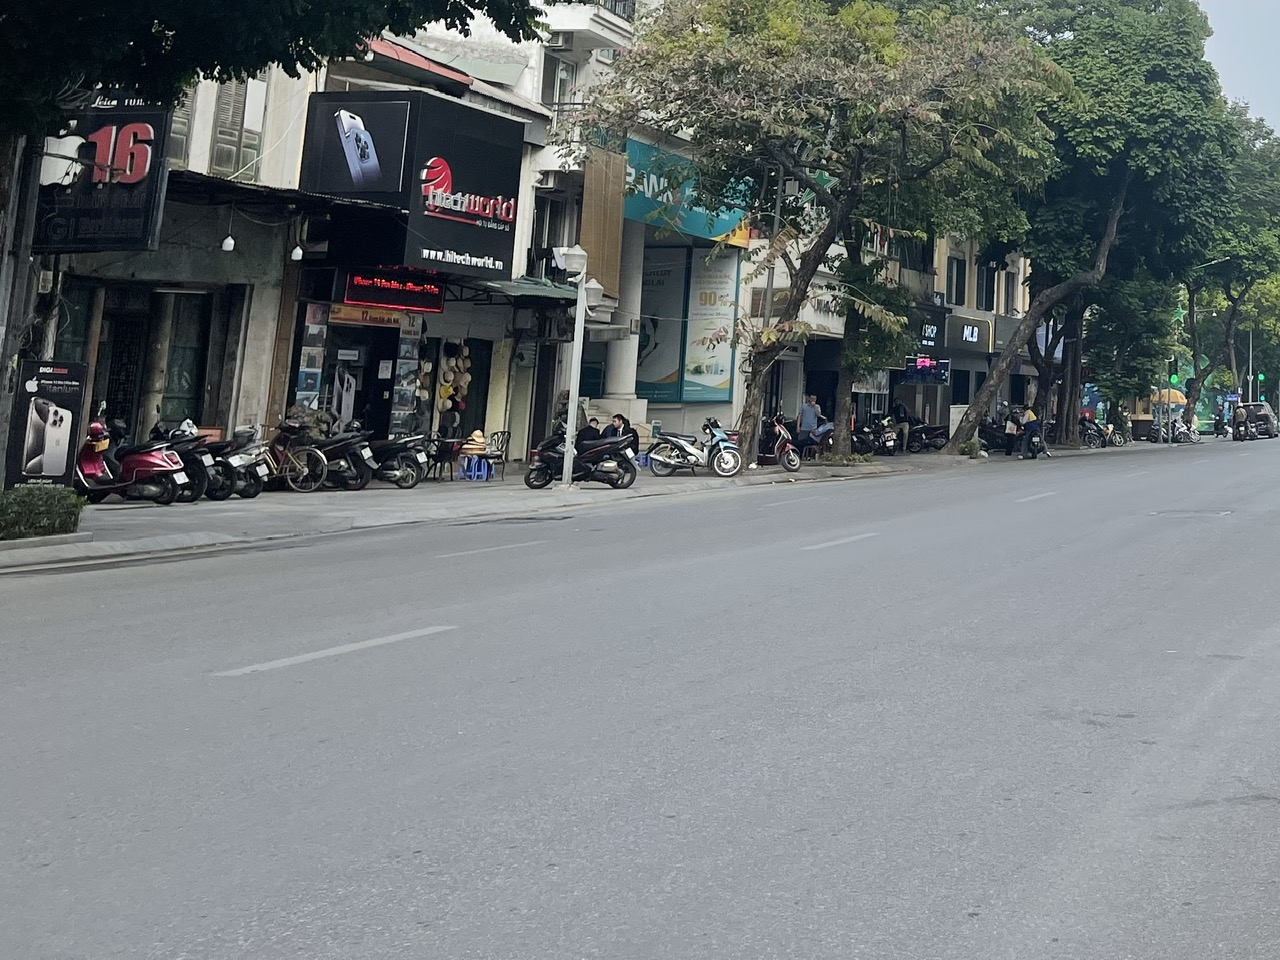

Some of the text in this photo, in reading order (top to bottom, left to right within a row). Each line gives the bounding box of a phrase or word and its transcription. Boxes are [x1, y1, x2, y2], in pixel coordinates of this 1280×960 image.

[91, 95, 118, 109] Leica
[88, 122, 155, 184] 16
[962, 324, 979, 343] MLB
